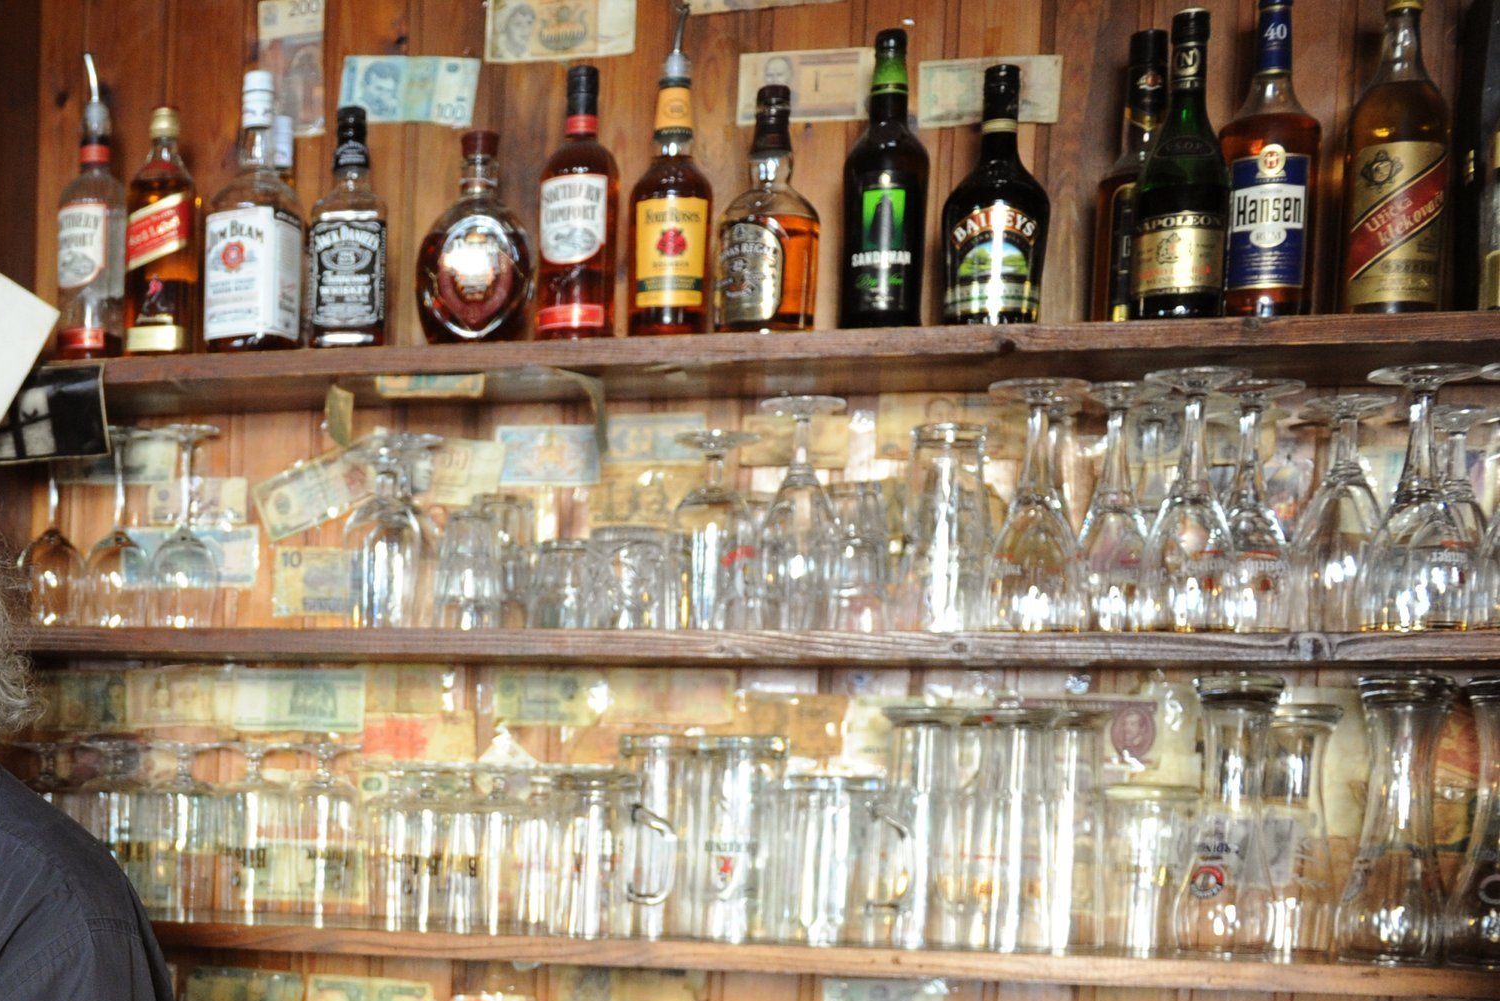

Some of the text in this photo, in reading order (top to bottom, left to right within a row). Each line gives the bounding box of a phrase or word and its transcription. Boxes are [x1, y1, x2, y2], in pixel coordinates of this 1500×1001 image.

[1263, 22, 1288, 40] 40
[1236, 195, 1303, 227] Hansen
[231, 219, 264, 244] BEAM
[953, 210, 1036, 242] BAIEYS
[852, 250, 912, 268] SANDMAN
